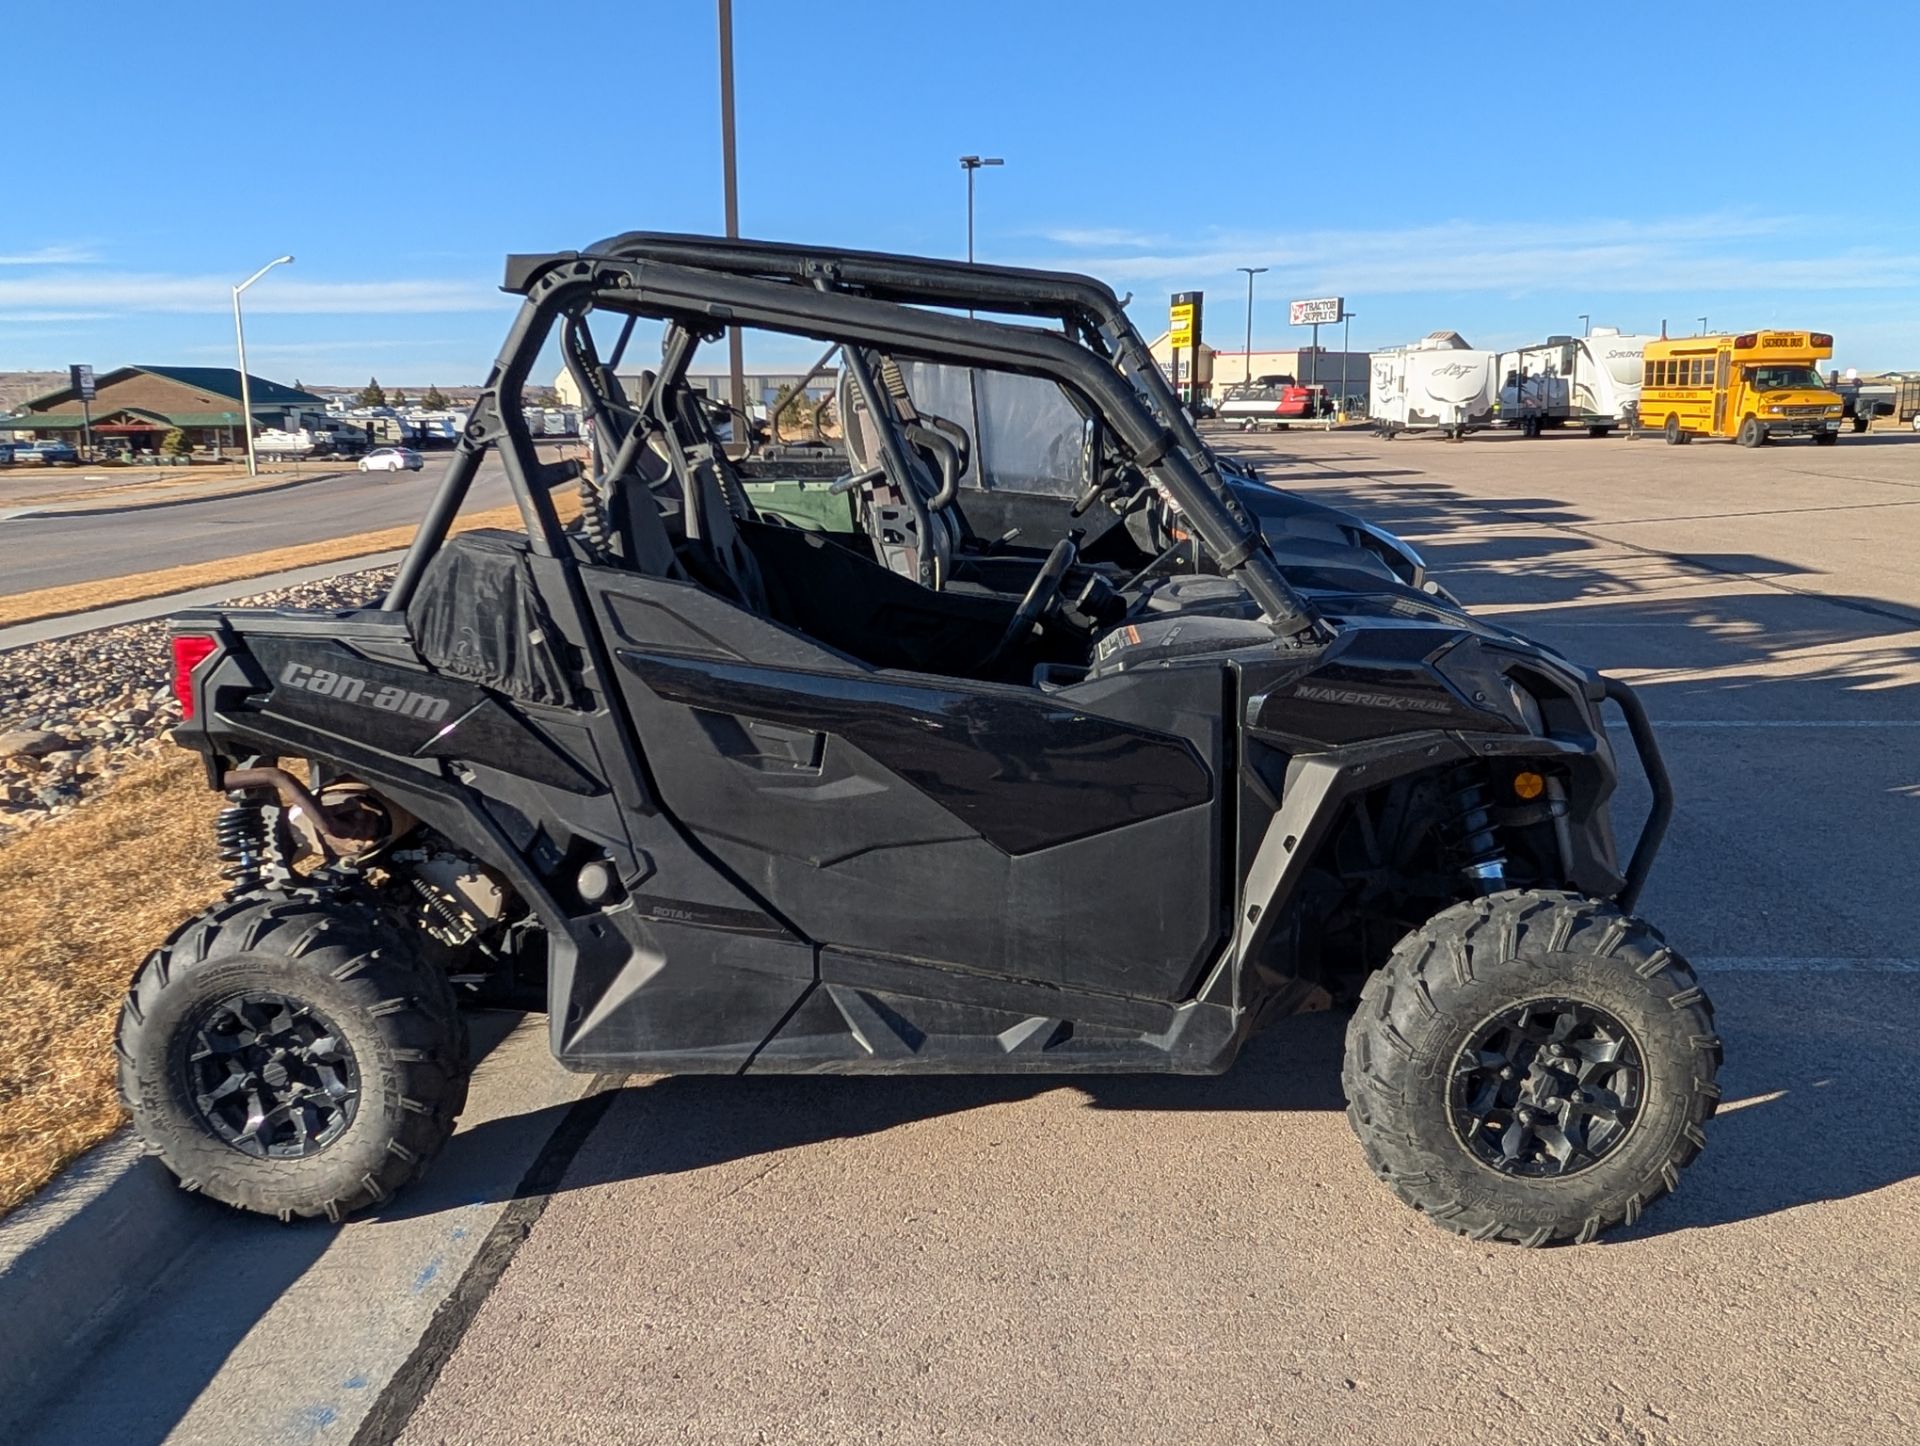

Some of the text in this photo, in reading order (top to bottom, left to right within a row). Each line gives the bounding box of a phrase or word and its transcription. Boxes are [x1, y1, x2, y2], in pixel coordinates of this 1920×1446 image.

[1304, 301, 1337, 312] TRACTOR
[1763, 337, 1804, 348] SCHOOL BUS
[279, 660, 450, 722] can-am
[1294, 685, 1453, 712] MAVERICK TRAIL
[652, 905, 693, 920] ROTAX
